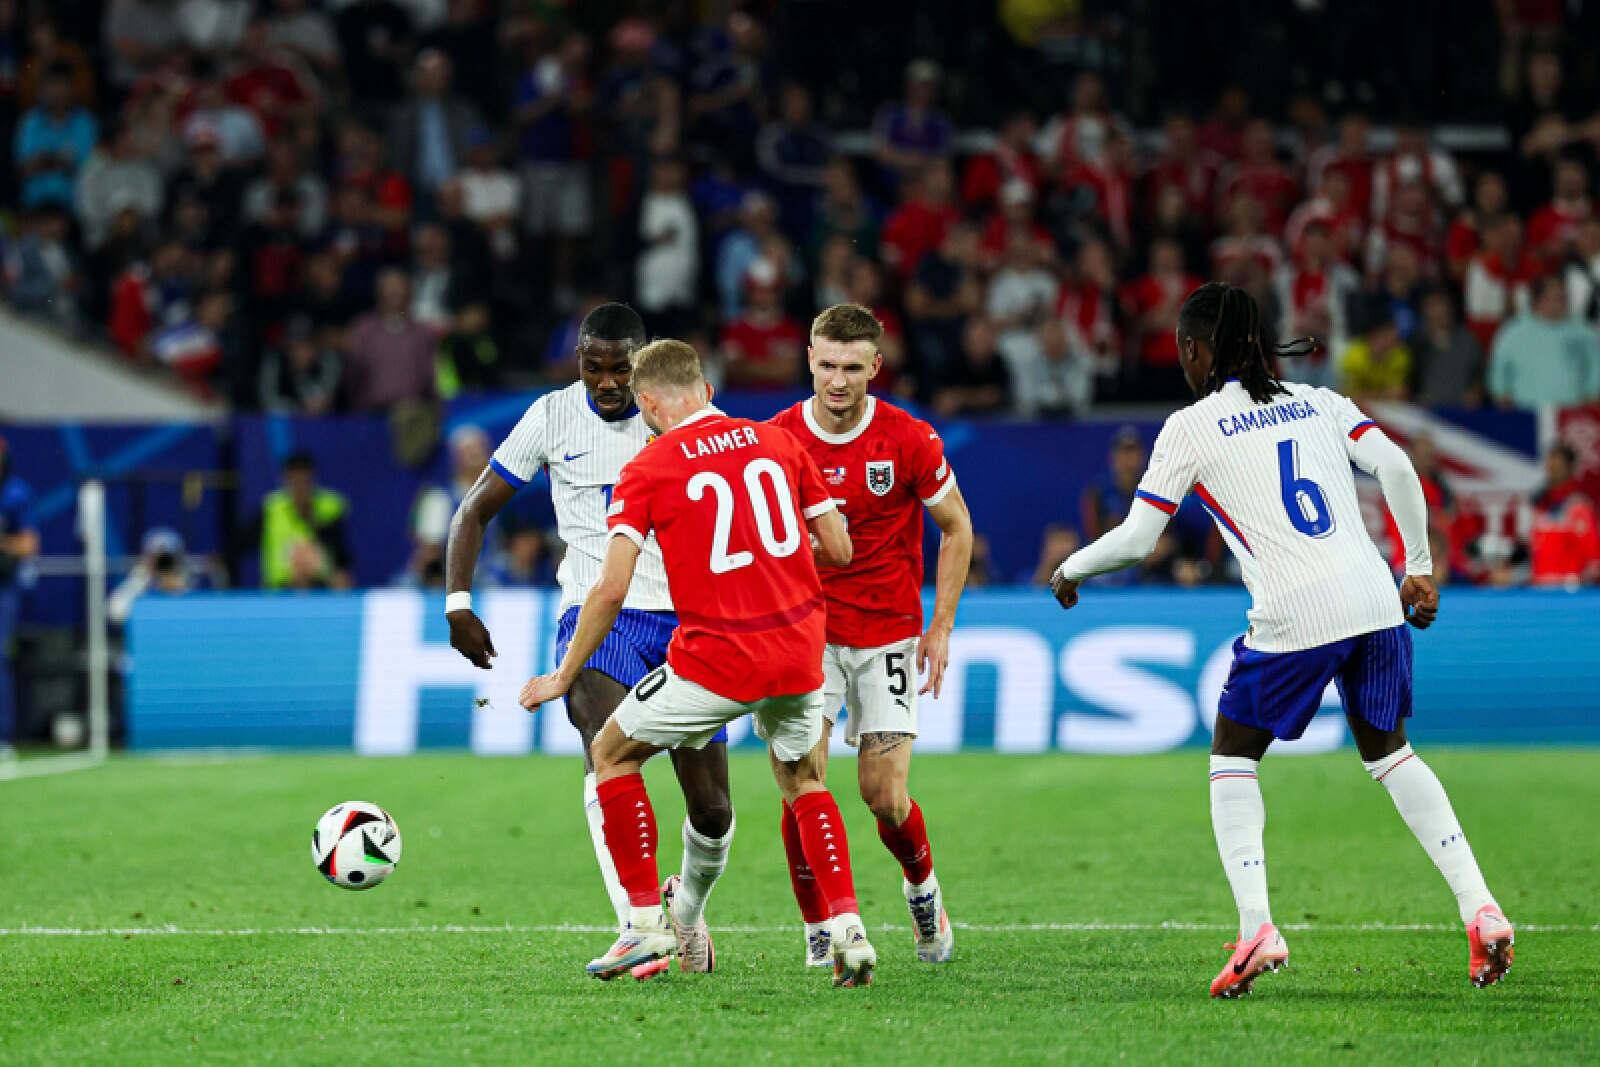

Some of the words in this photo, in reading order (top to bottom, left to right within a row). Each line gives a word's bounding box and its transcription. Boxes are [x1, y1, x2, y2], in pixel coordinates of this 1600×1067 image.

[1218, 399, 1321, 437] CAMAVINGA
[680, 424, 760, 459] LAIMER
[1277, 439, 1337, 539] 6
[686, 457, 802, 574] 20
[885, 652, 907, 696] 5
